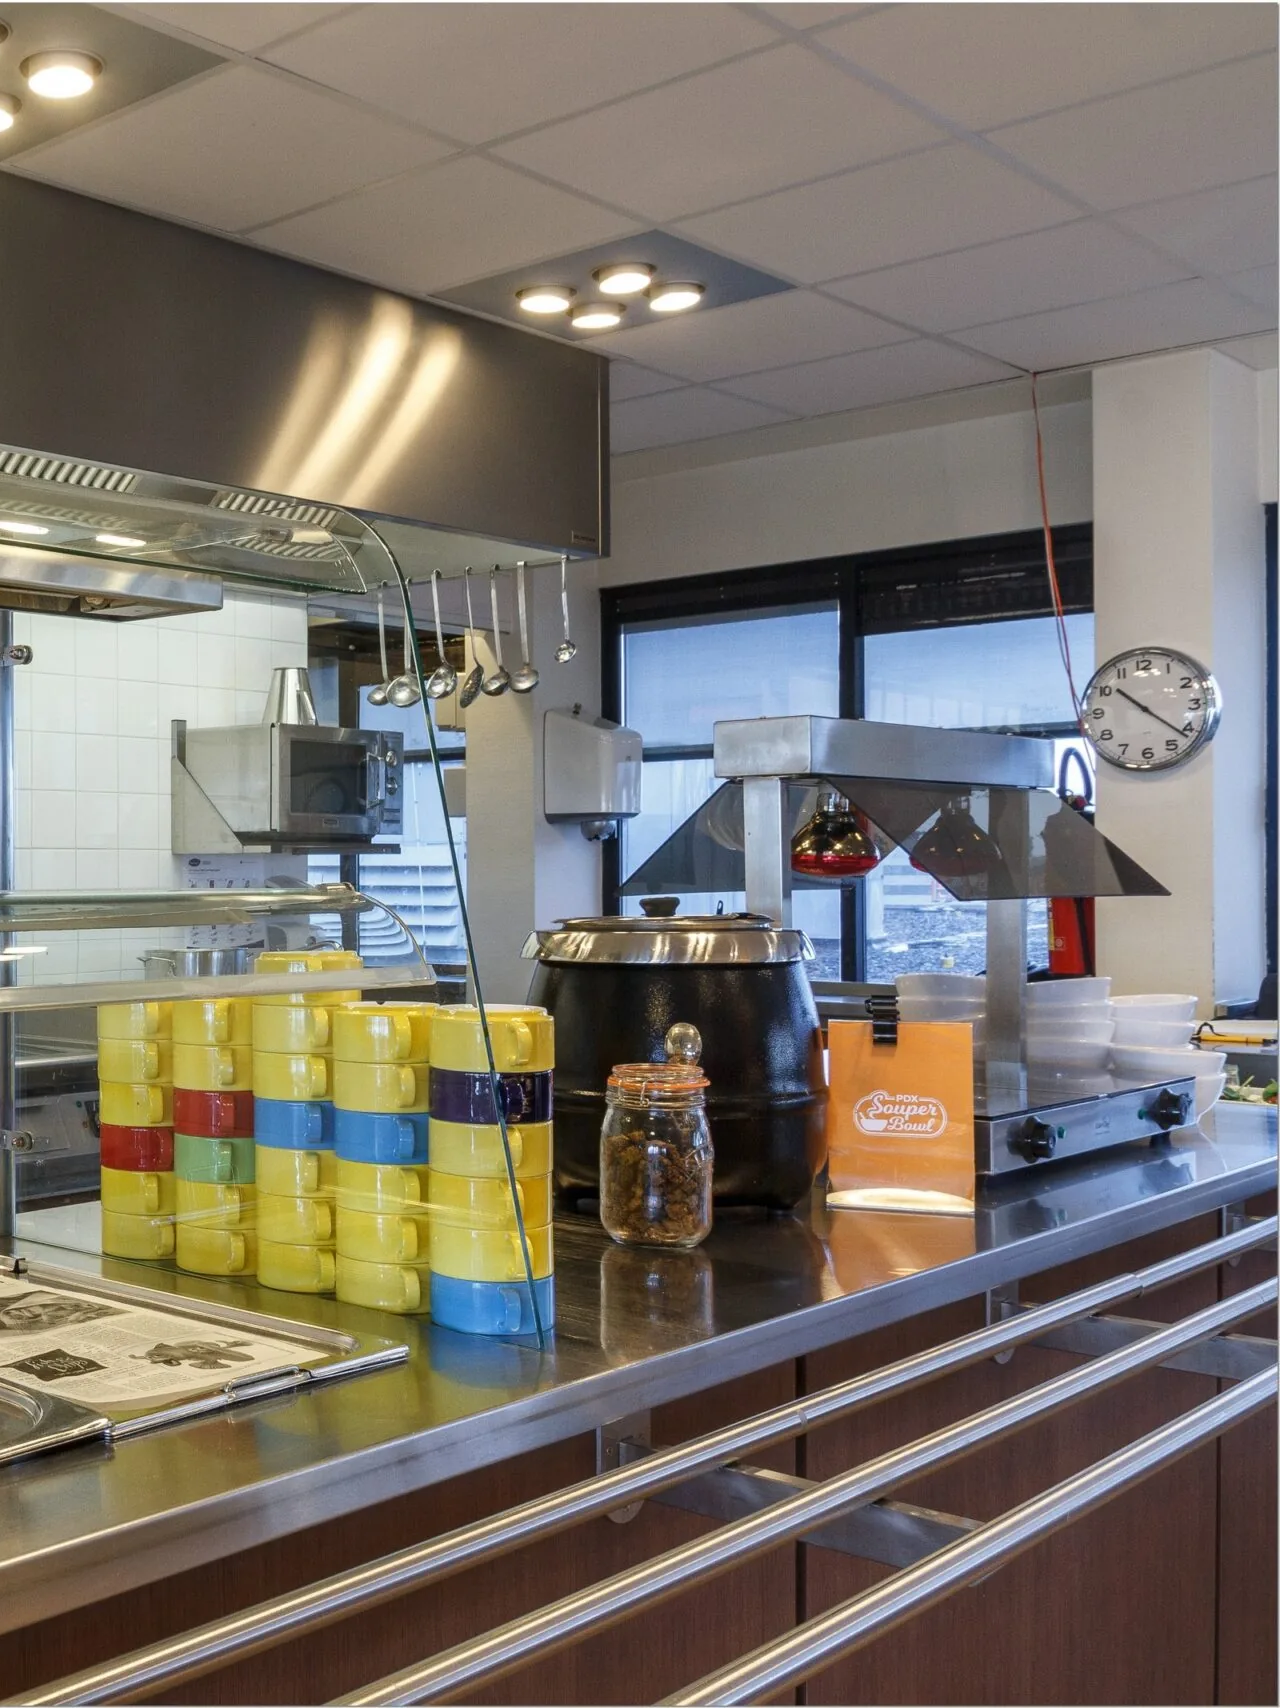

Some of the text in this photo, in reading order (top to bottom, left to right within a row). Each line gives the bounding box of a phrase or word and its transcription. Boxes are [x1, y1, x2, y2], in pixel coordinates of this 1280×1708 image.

[1135, 659, 1152, 671] 12
[1166, 663, 1171, 674] 1
[1116, 668, 1127, 679] 11
[1180, 677, 1192, 689] 2
[1099, 685, 1112, 697] 10
[1188, 698, 1201, 711] 3
[1092, 708, 1105, 720] 9
[1182, 721, 1194, 733] 4
[1100, 729, 1114, 741] 8
[1118, 744, 1129, 756] 7
[1165, 740, 1178, 752] 5
[1141, 748, 1154, 760] 6
[895, 1094, 919, 1103] PDX
[867, 1093, 938, 1120] Souper
[887, 1116, 936, 1132] Bowl
